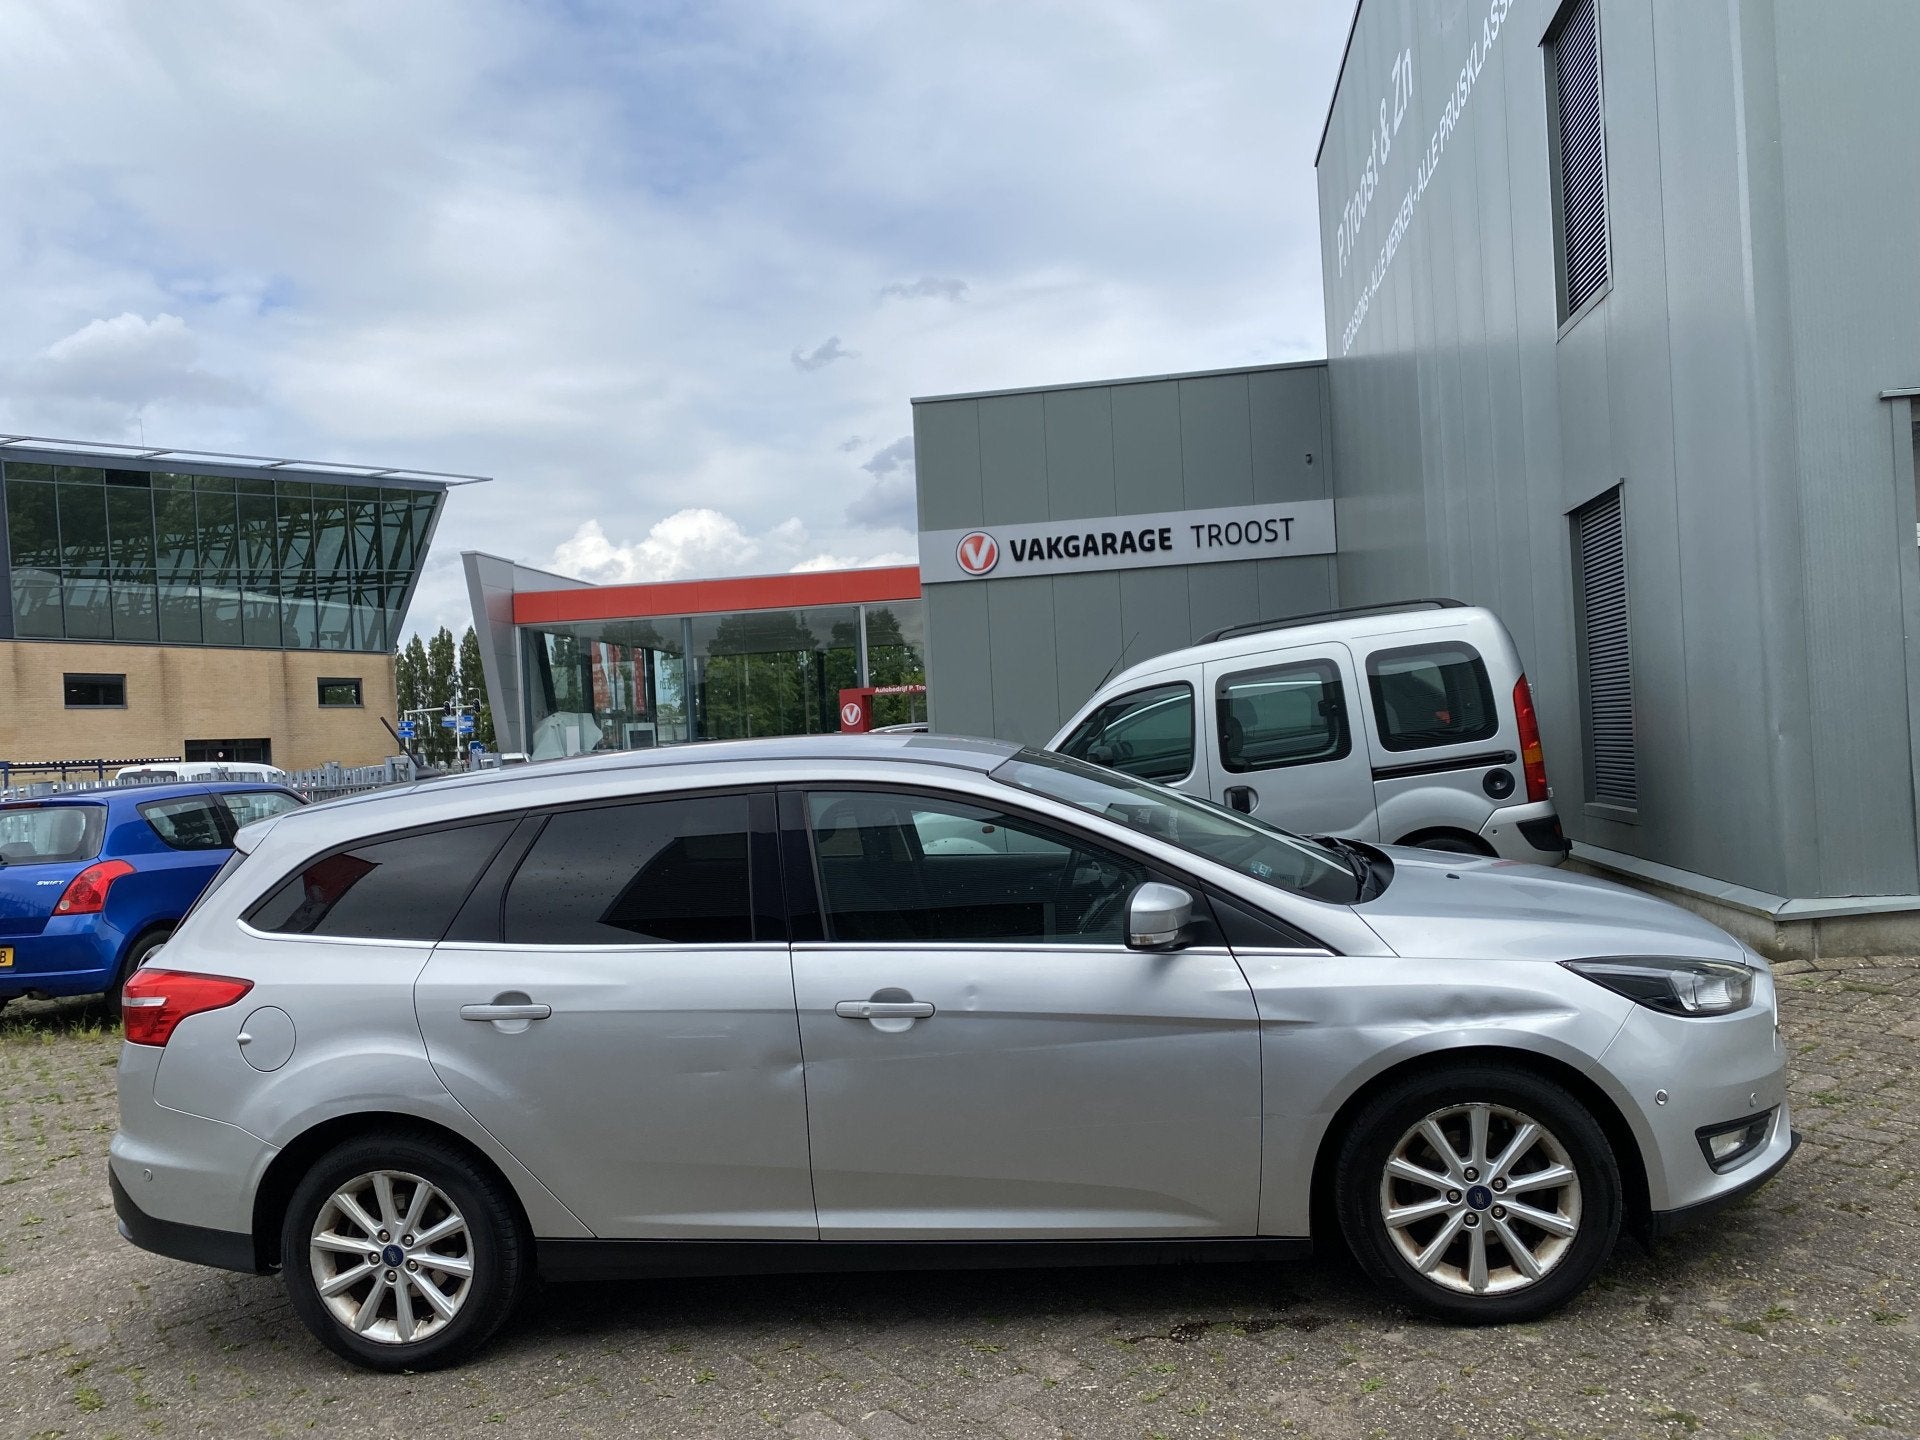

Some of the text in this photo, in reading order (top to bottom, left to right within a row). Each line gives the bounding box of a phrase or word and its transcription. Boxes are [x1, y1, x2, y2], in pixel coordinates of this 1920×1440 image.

[1380, 97, 1391, 165] &
[1391, 48, 1413, 136] Zn
[1385, 185, 1414, 267] WERKEN
[1417, 131, 1439, 201] ALLE
[1439, 0, 1514, 153] PRIJSKLASS
[1009, 517, 1295, 563] VAKGARAGE TROOST
[875, 684, 908, 693] Autobedrijf
